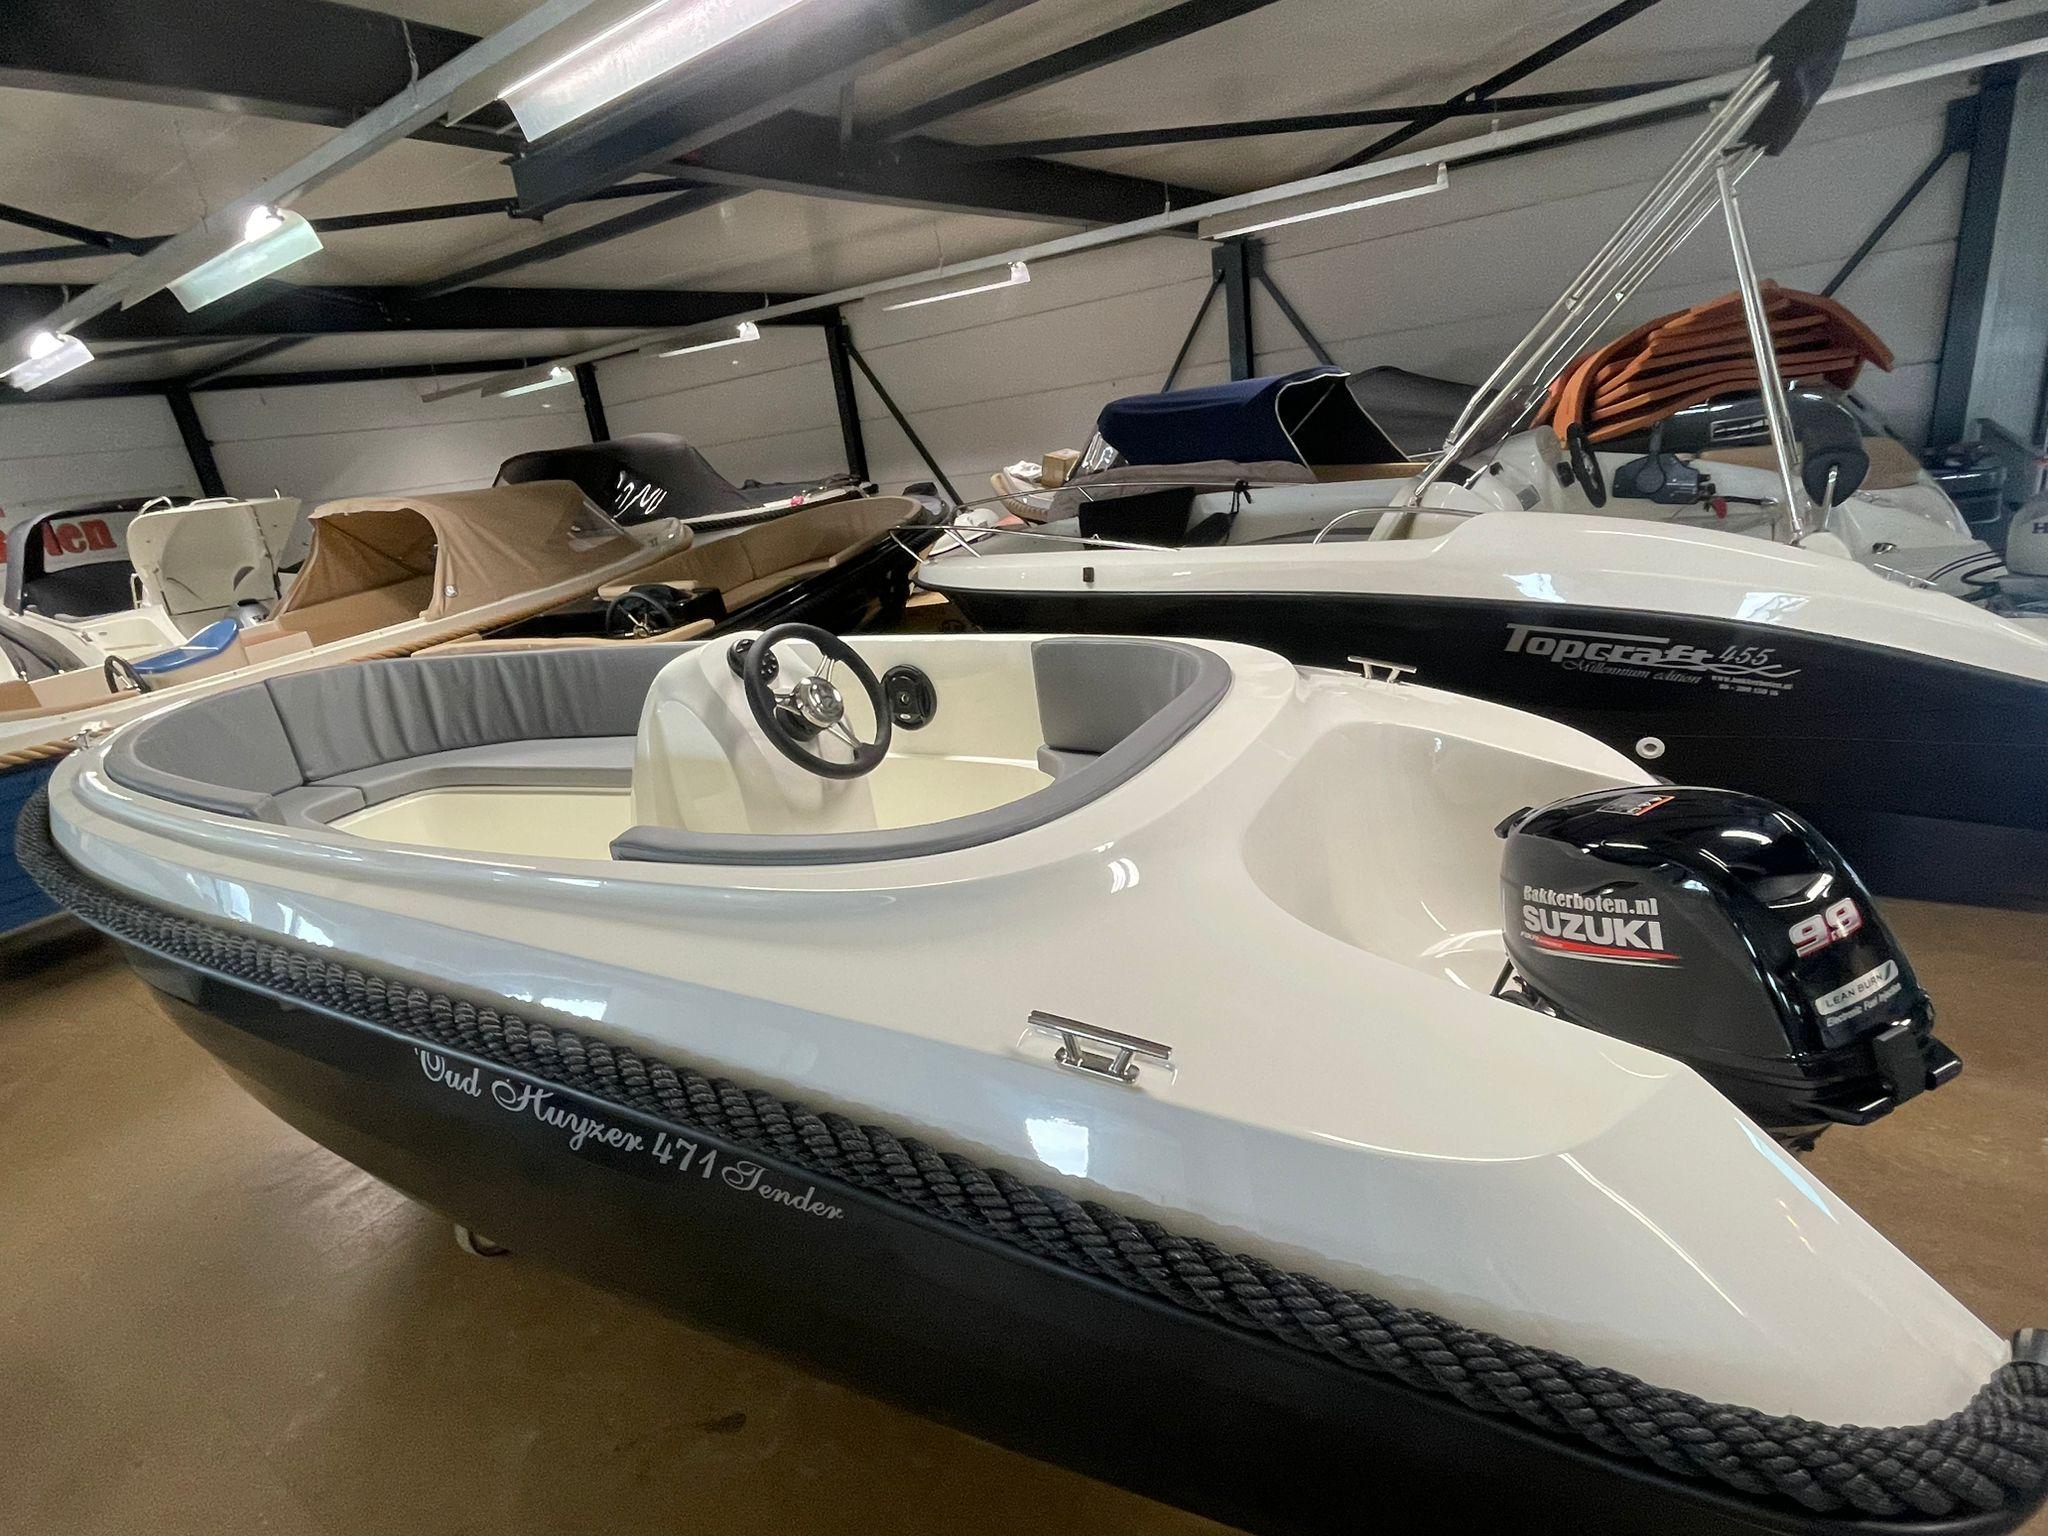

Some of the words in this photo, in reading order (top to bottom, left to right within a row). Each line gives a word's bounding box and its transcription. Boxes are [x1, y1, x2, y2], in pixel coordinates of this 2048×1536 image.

[1504, 623, 1714, 669] Topcraft
[1718, 645, 1775, 666] 455
[1523, 885, 1659, 916] Bakkerboten.nl
[1523, 904, 1664, 951] SUZUKI
[1825, 988, 1856, 1008] LEAN
[1857, 973, 1884, 993] BURN
[415, 1047, 481, 1097] Oud
[491, 1078, 644, 1151] Huyzer
[652, 1132, 717, 1179] 471
[721, 1160, 844, 1219] Tender
